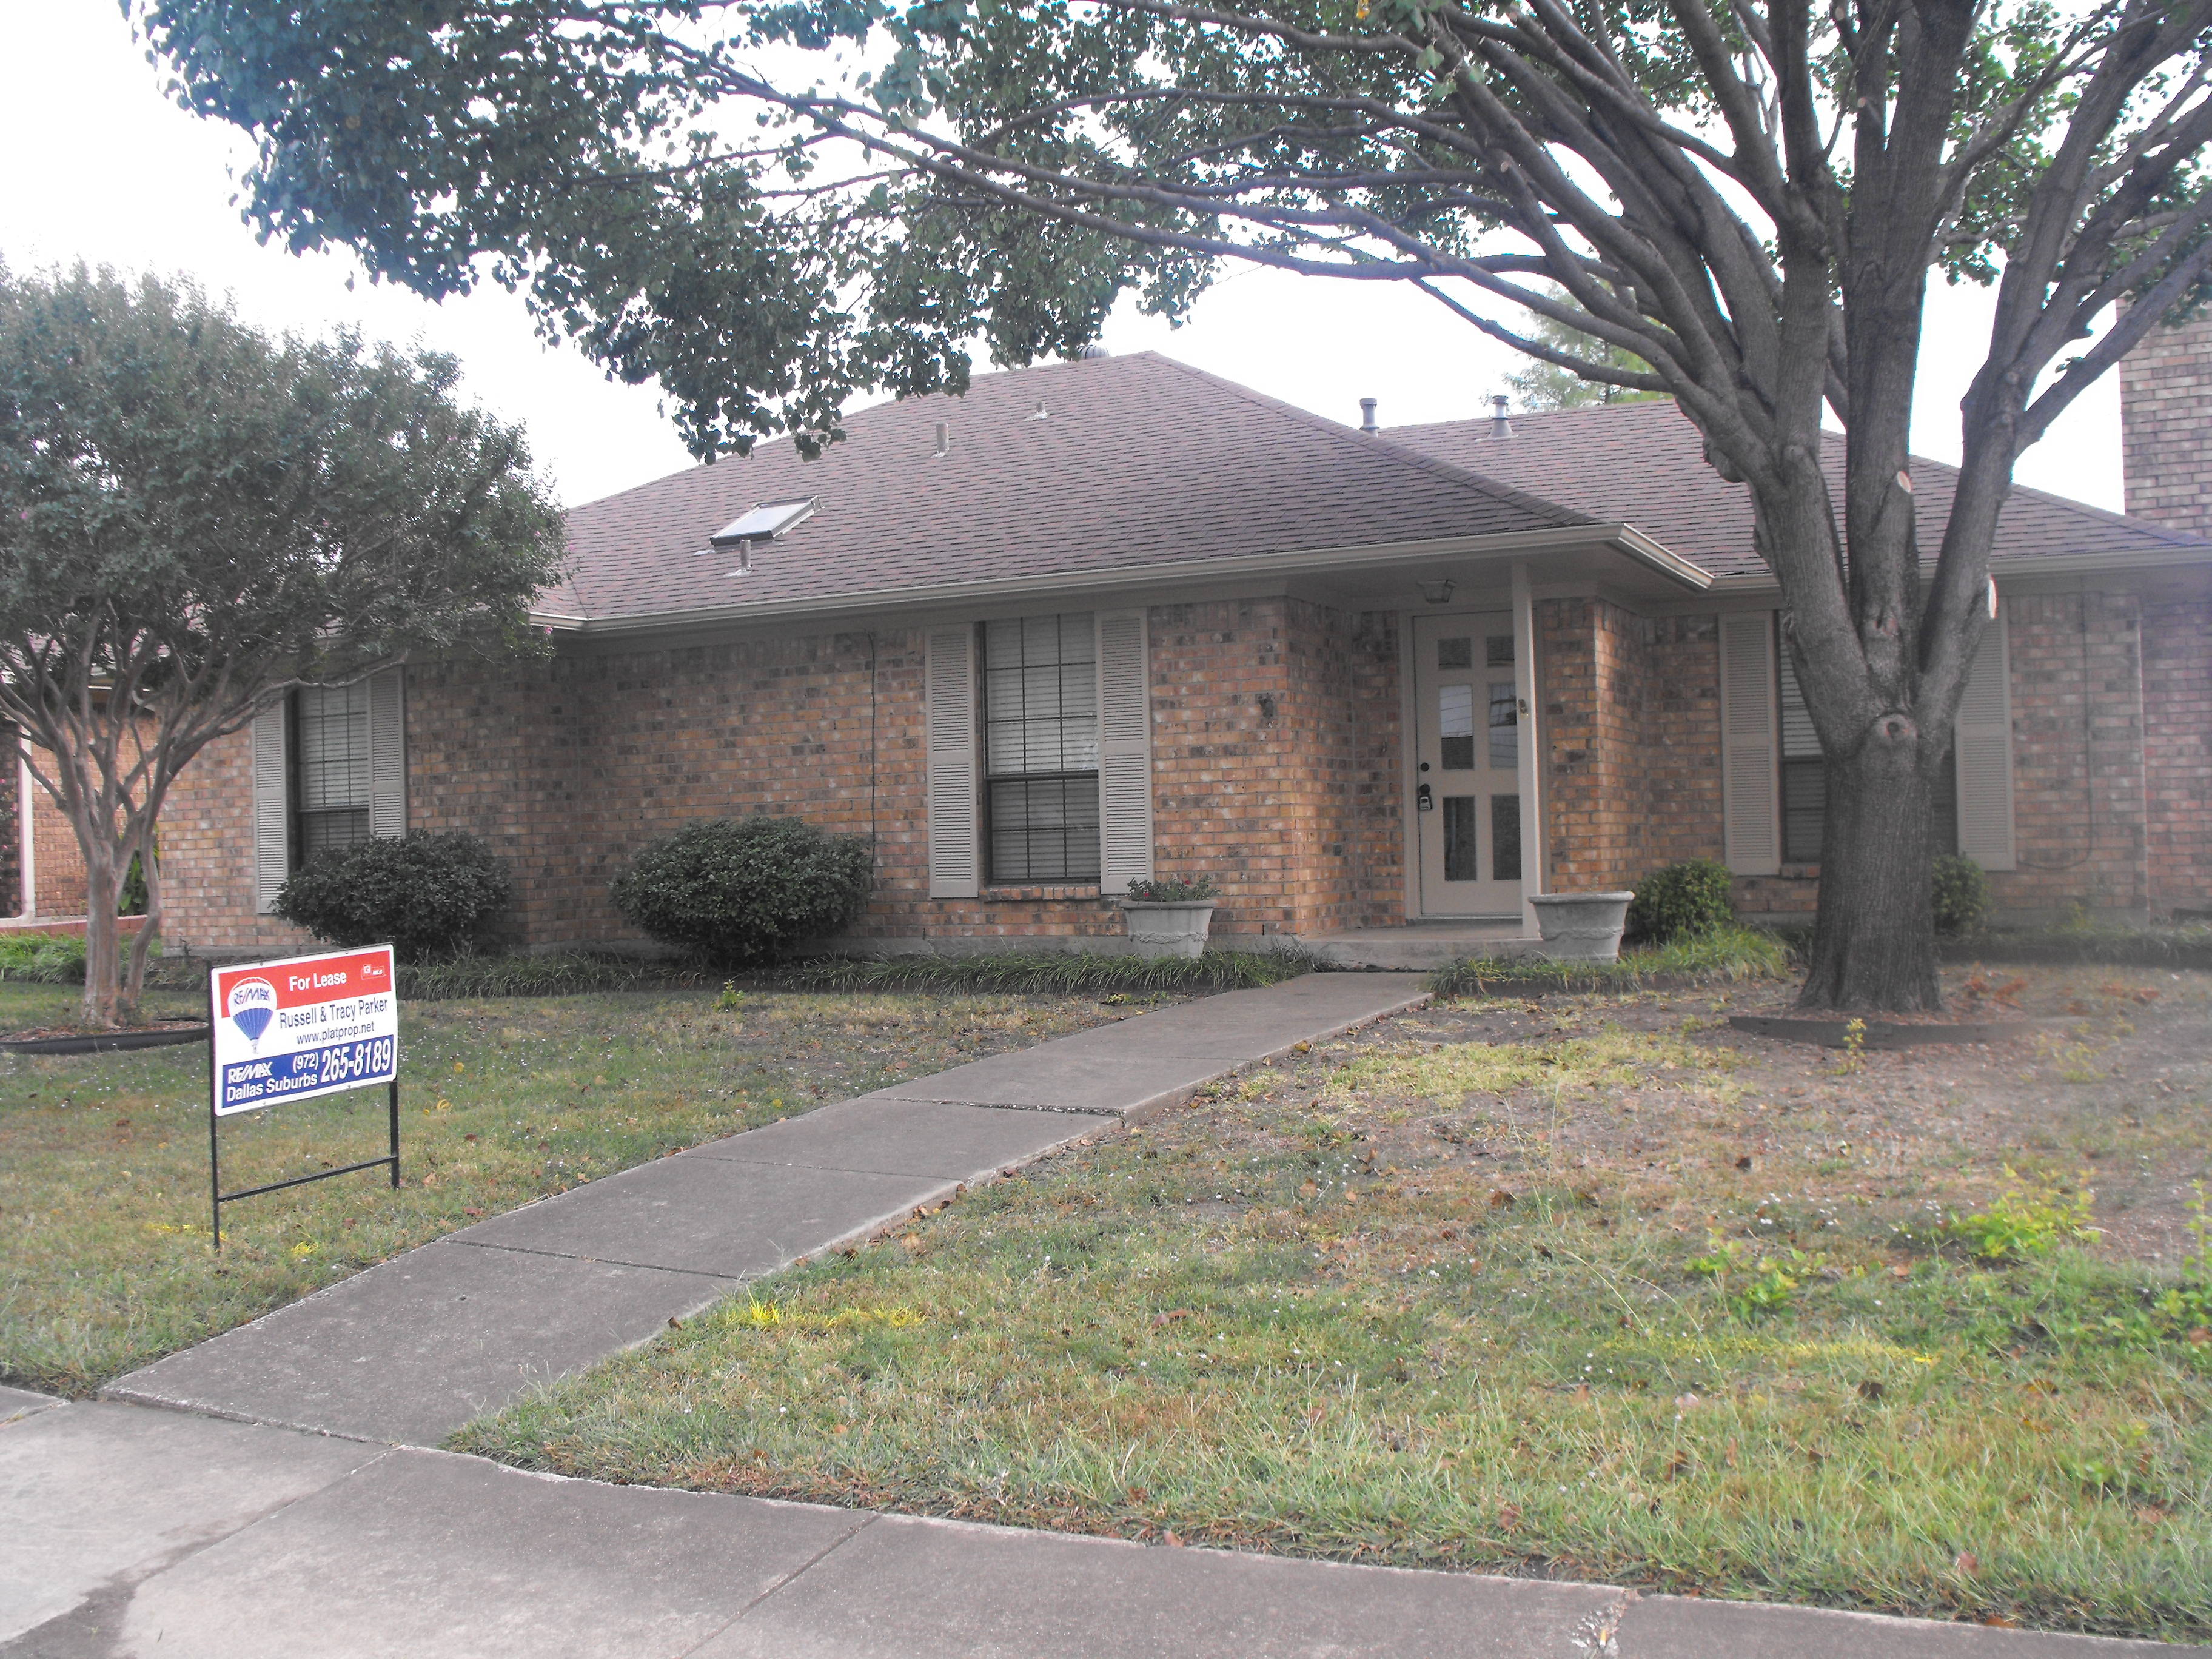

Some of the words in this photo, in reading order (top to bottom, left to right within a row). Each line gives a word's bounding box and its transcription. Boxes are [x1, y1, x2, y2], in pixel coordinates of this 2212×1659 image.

[289, 976, 310, 991] For
[314, 972, 347, 988] Lease
[233, 988, 270, 1005] RE/MAX
[280, 1008, 317, 1029] Russell
[321, 1008, 327, 1022] &
[330, 1003, 355, 1022] Tracy
[359, 999, 388, 1014] Parker
[297, 1022, 374, 1044] www.platprop.net
[293, 1052, 319, 1073] (972)
[321, 1039, 391, 1083] 265-8189
[228, 1062, 273, 1084] RE/MAX
[227, 1083, 263, 1102] Dallas
[266, 1073, 317, 1093] Suburbs
